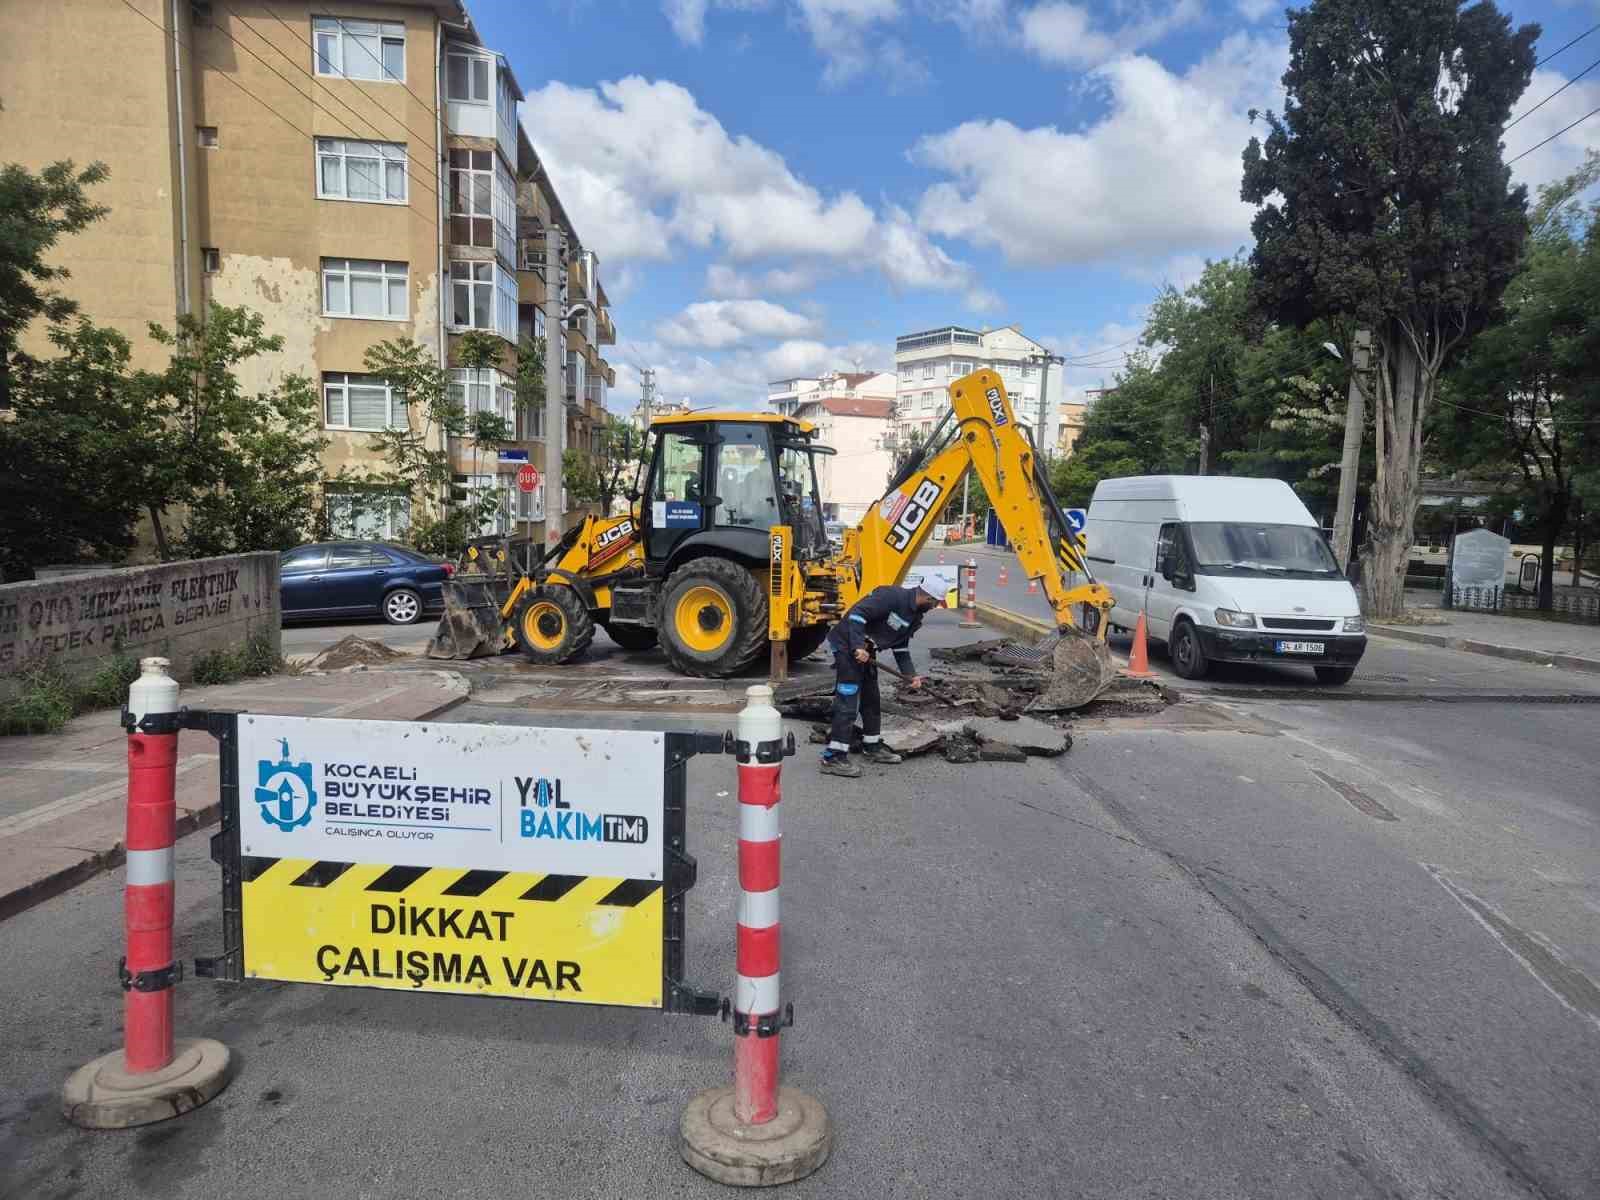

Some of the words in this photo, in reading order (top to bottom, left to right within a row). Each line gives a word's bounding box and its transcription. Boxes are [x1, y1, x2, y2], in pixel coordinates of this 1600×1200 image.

[519, 472, 537, 484] DUR
[893, 480, 940, 550] JCB
[597, 520, 633, 547] JCB
[514, 776, 570, 809] YOL
[387, 830, 434, 841] OLUYOR
[520, 809, 602, 842] BAKIM
[371, 898, 515, 942] DİKKAT
[316, 944, 493, 988] ÇALIŞMA
[502, 956, 582, 992] VAR
